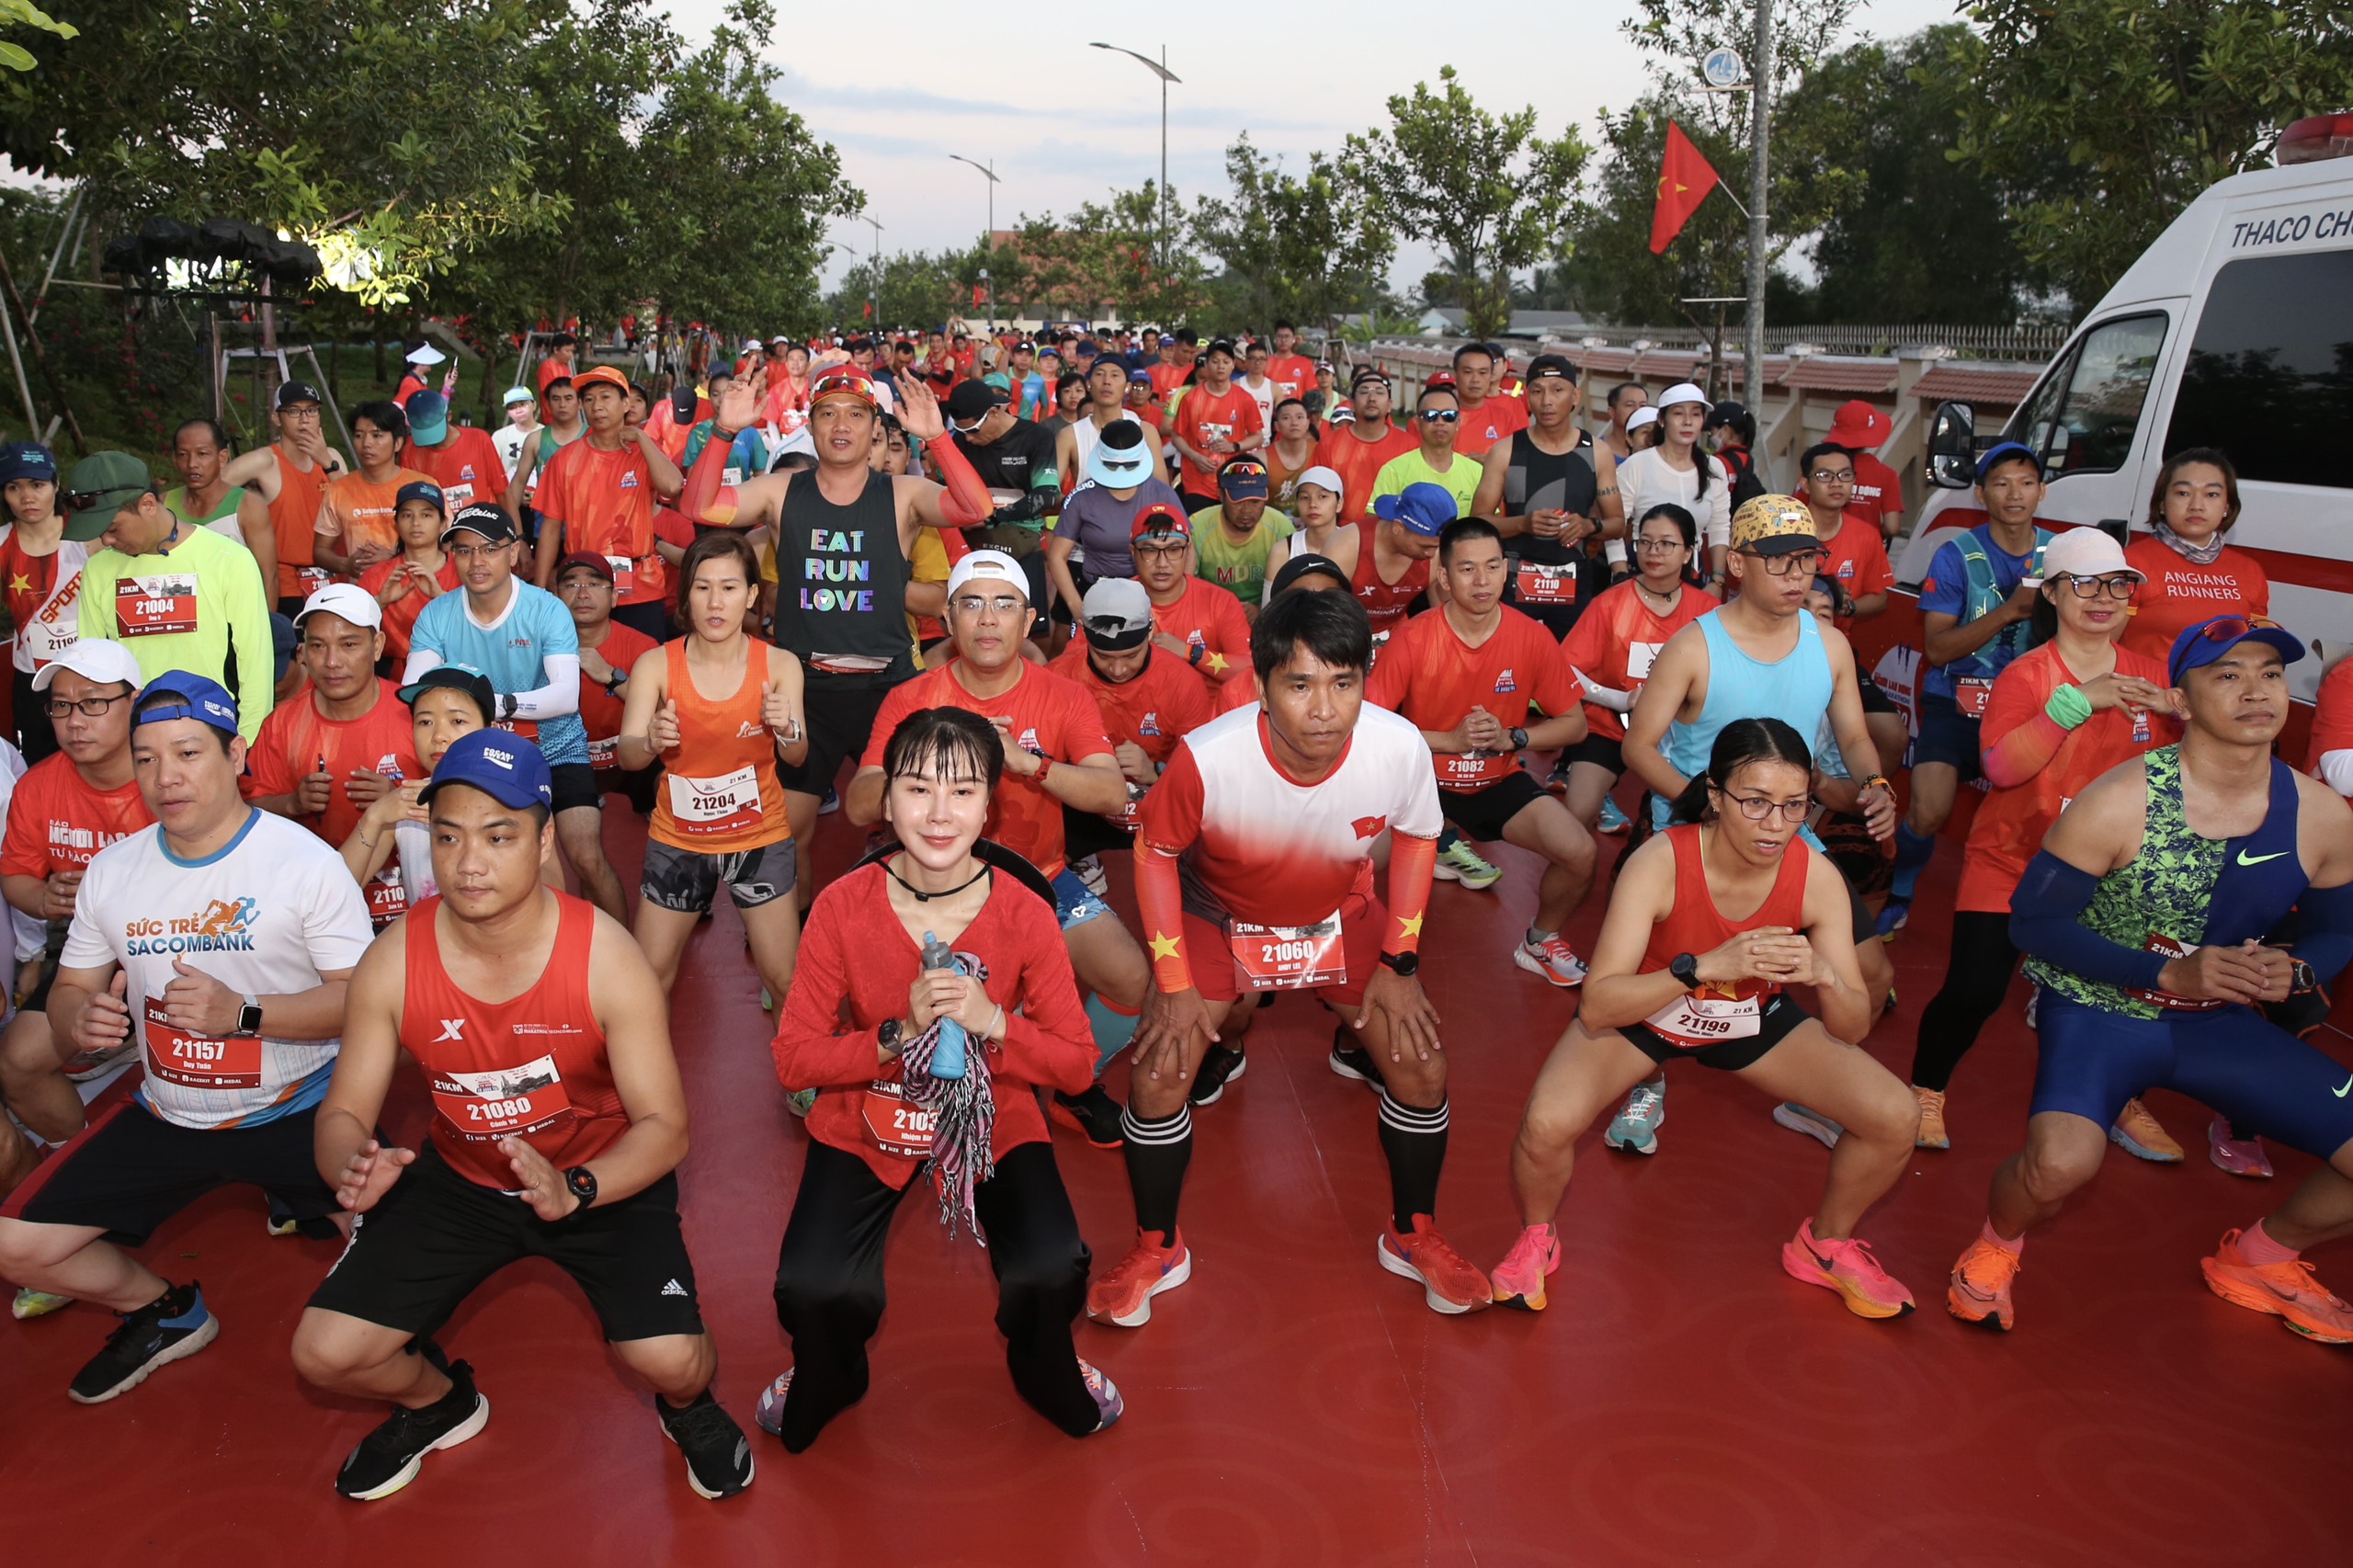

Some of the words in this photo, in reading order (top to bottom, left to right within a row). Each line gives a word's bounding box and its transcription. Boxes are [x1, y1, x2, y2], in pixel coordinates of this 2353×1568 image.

[2232, 214, 2312, 248] THACO
[2314, 210, 2353, 239] CH
[1063, 480, 1096, 510] ADIZERO
[811, 528, 864, 552] EAT
[805, 558, 870, 582] RUN
[1216, 564, 1264, 585] MDR
[2165, 571, 2237, 586] ANGIANG
[119, 585, 139, 595] 21KM
[1533, 578, 1560, 590] 21110
[2166, 585, 2242, 600] RUNNERS
[135, 598, 175, 615] 21004
[800, 587, 874, 612] LOVE
[1448, 759, 1485, 772] 21082
[692, 792, 736, 810] 21204
[126, 916, 163, 937] SỨC
[169, 912, 199, 935] TRẺ
[127, 934, 255, 957] SACOMBANK
[1261, 939, 1315, 963] 21060
[2150, 942, 2184, 960] 21KM
[1292, 961, 1302, 970] LEE
[1733, 1006, 1742, 1015] 21
[1677, 1014, 1731, 1033] 21199
[172, 1038, 225, 1061] 21157
[183, 1061, 195, 1070] Duy
[434, 1079, 464, 1093] 21KM
[872, 1078, 902, 1096] 21KM
[466, 1096, 532, 1121] 21080
[661, 1289, 688, 1297] adidas
